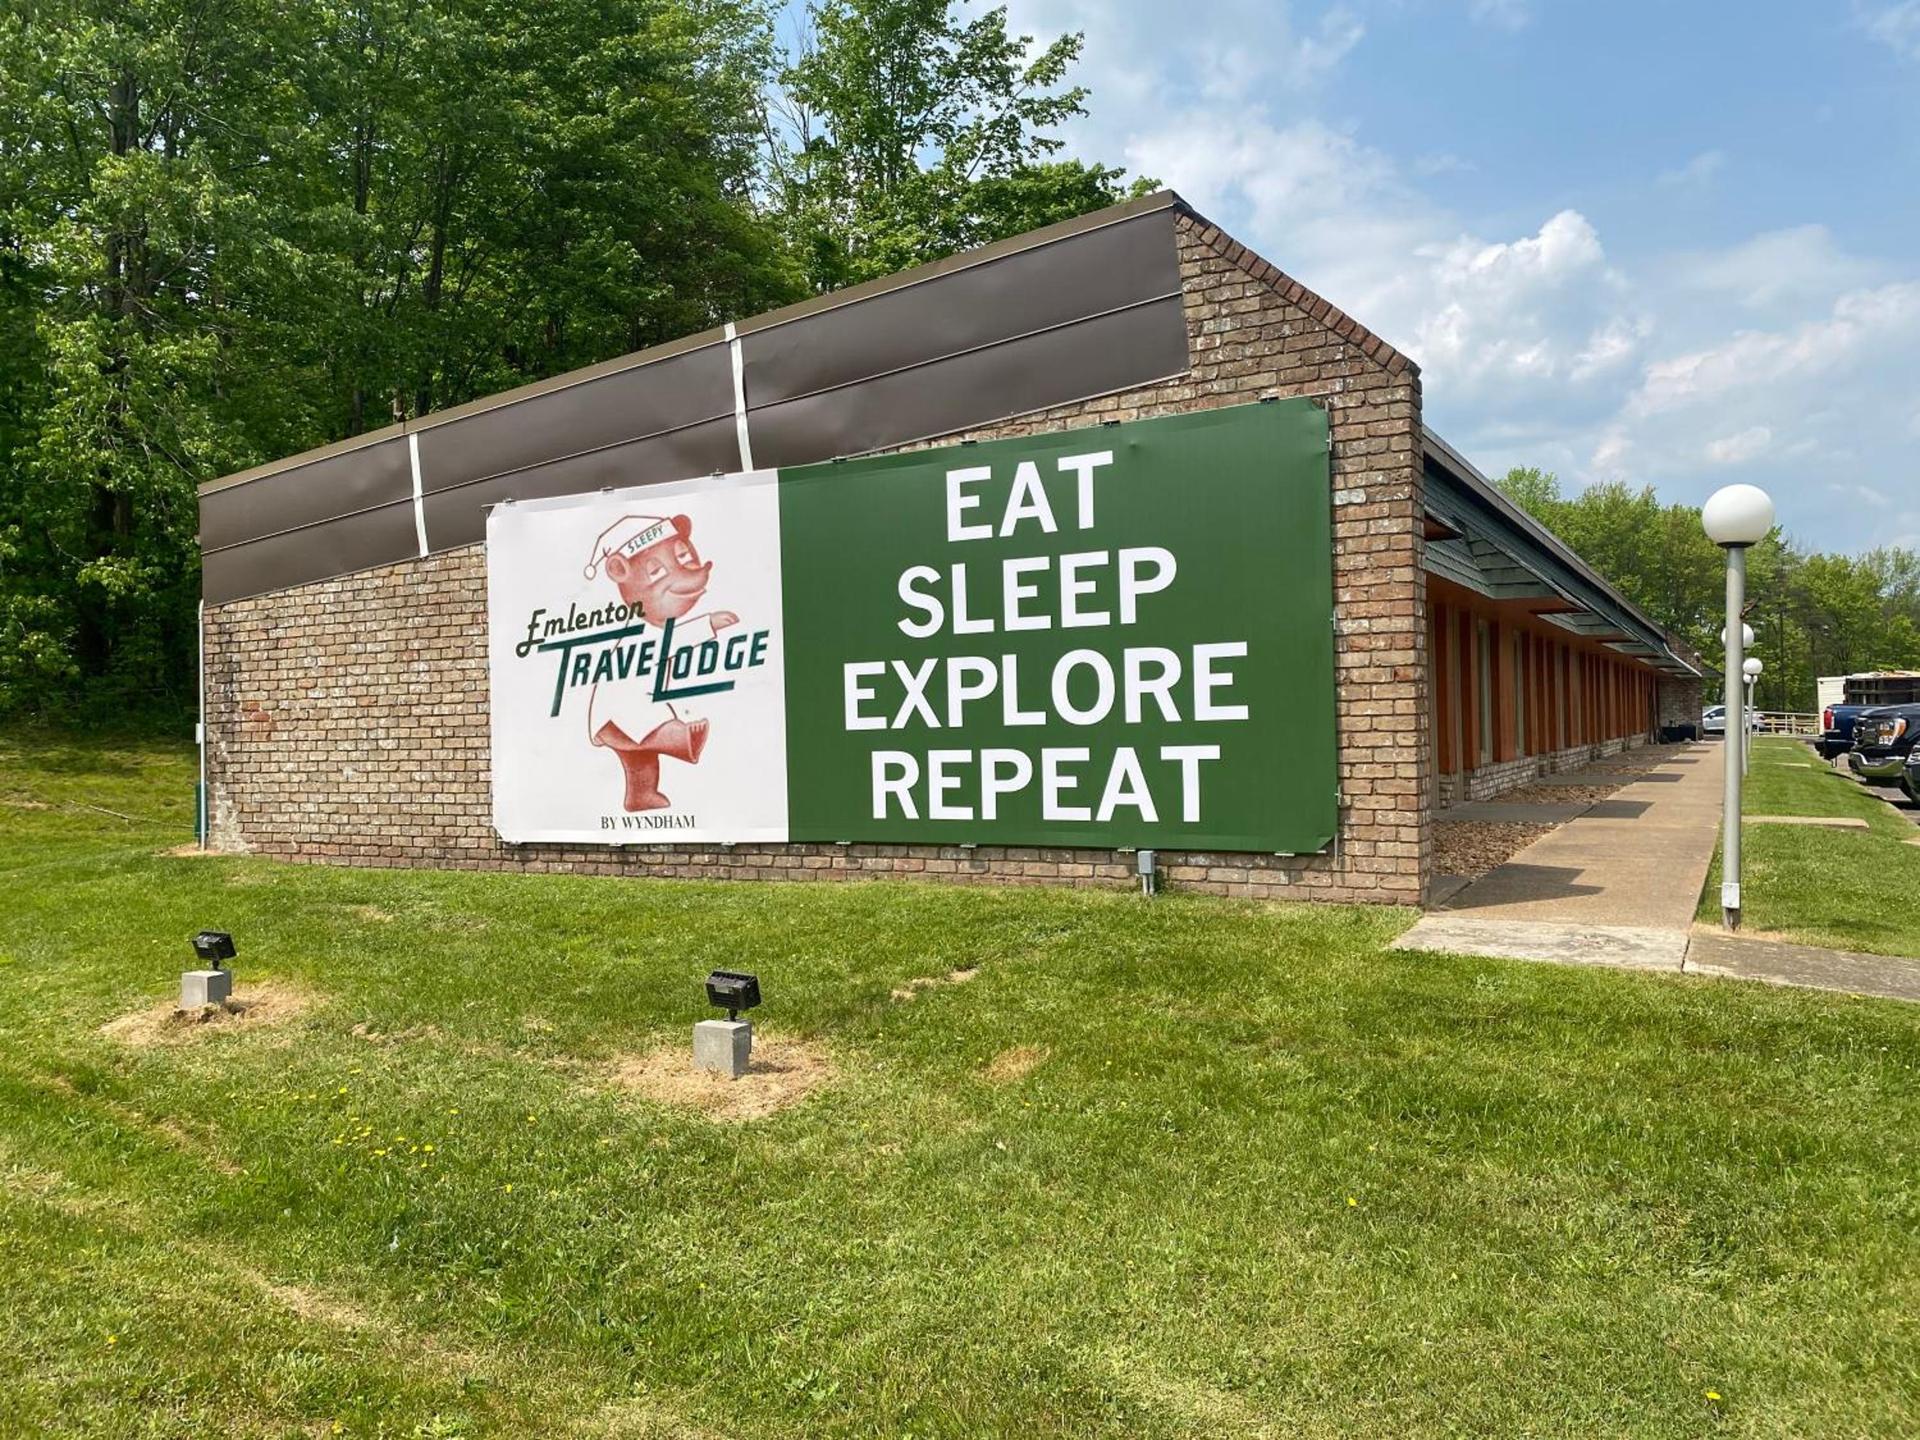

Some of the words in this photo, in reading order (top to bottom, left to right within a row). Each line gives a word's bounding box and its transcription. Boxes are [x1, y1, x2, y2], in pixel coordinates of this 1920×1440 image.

[946, 450, 1113, 542] EAT
[627, 524, 664, 553] SLEEPY
[516, 600, 645, 658] Emlenton
[898, 546, 1177, 638] SLEEP
[843, 641, 1249, 731] EXPLORE
[601, 816, 618, 830] BY
[622, 815, 696, 830] WYNDHAM
[871, 745, 1221, 823] REPEAT
